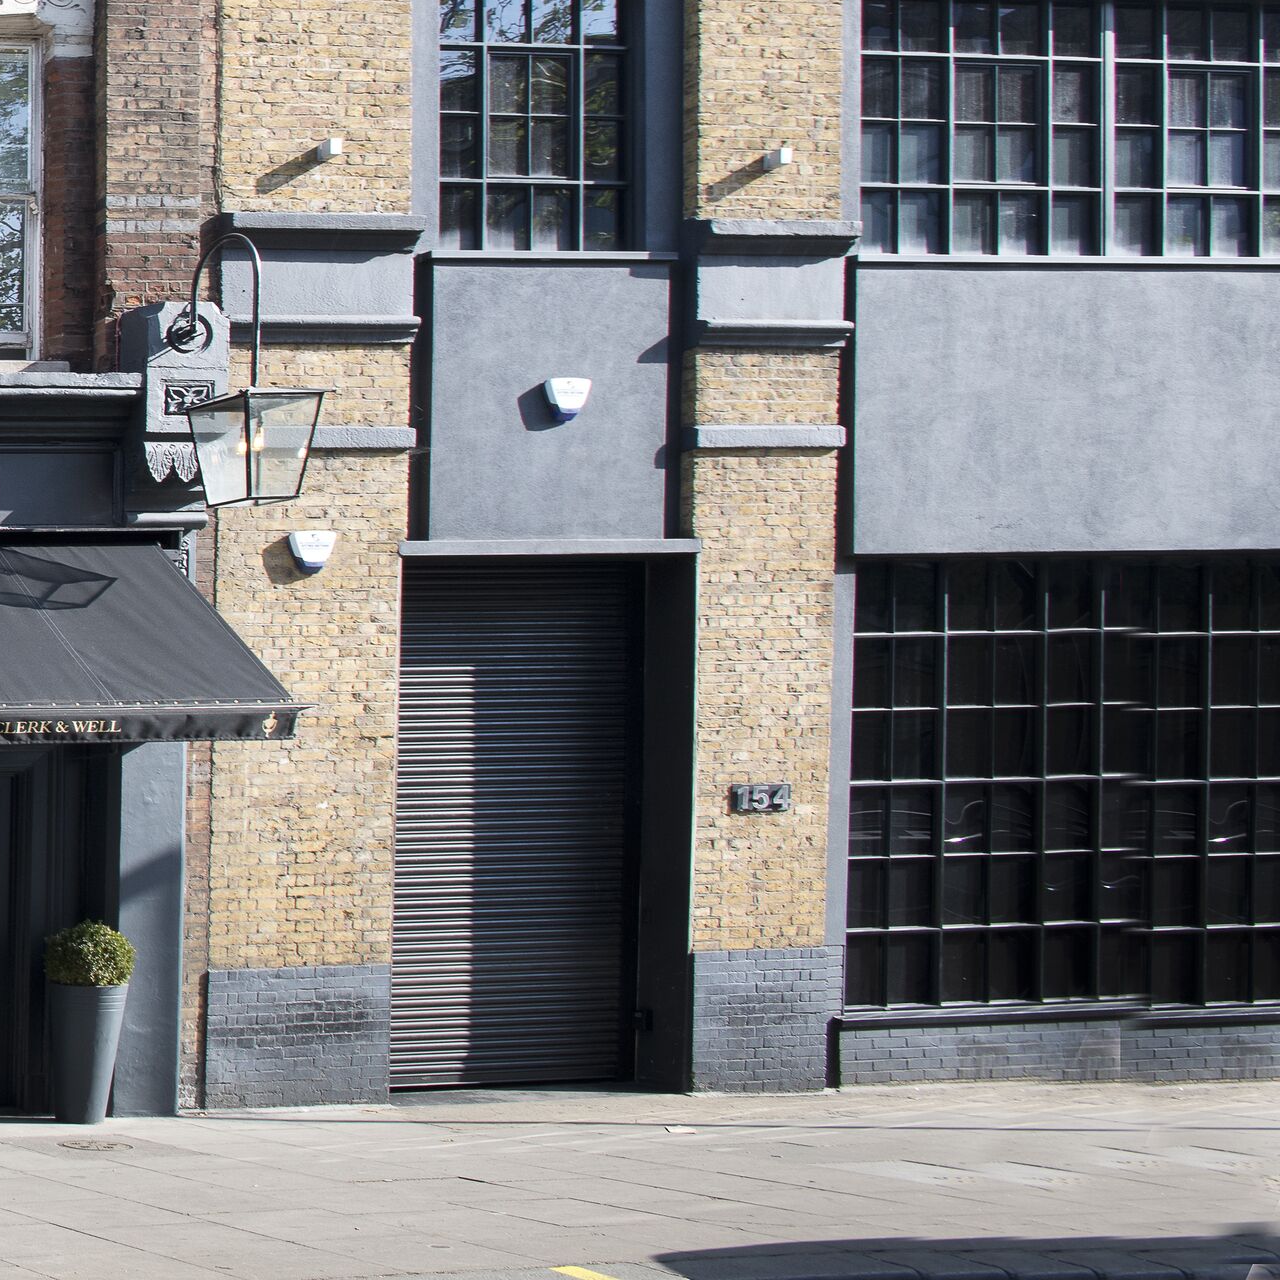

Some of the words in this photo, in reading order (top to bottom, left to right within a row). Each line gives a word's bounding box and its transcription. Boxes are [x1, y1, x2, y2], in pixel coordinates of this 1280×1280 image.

[55, 720, 69, 733] &
[72, 719, 122, 733] WELL
[737, 784, 789, 811] 154
